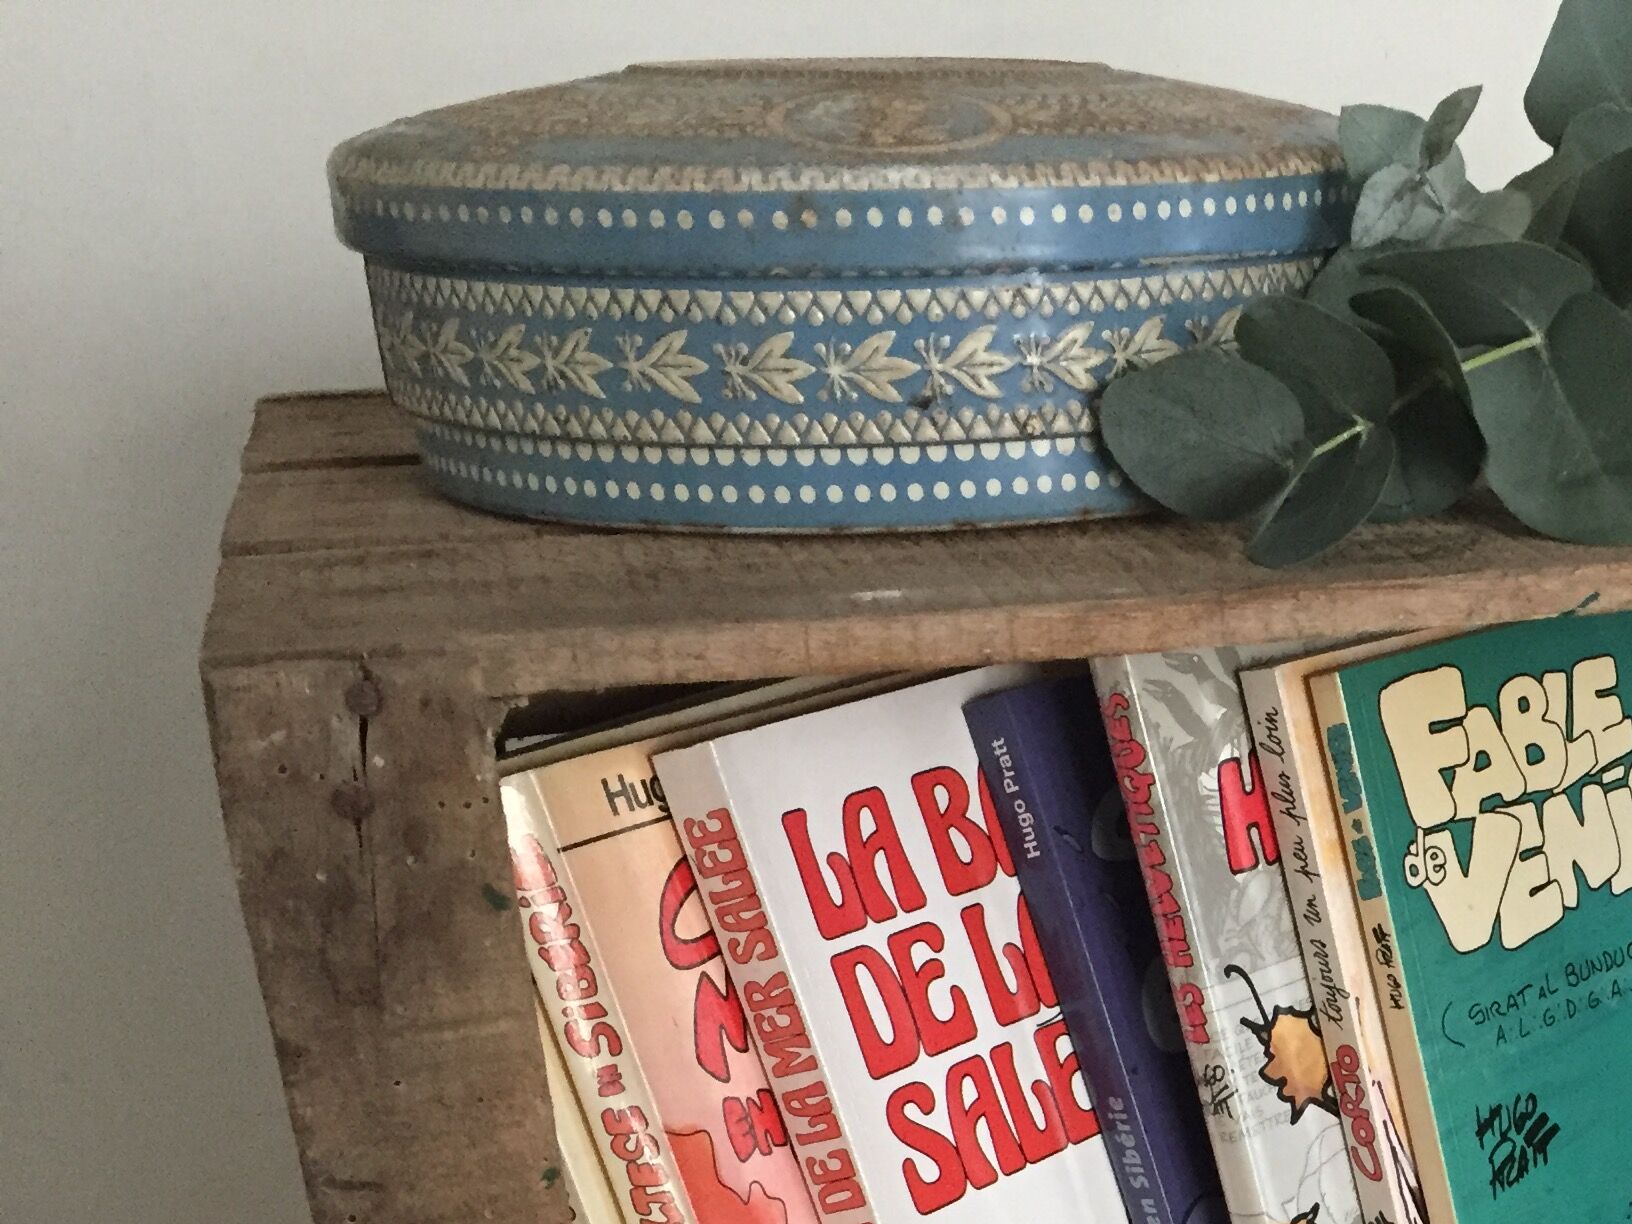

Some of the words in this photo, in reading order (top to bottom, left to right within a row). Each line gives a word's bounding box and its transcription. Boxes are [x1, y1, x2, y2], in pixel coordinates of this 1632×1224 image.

[992, 738, 1019, 794] Pratt
[1257, 706, 1285, 764] loin
[1012, 797, 1040, 859] Hugo
[1270, 770, 1307, 826] plus
[781, 787, 927, 941] LA
[1293, 835, 1321, 884] peu
[1403, 825, 1447, 888] de
[1303, 894, 1322, 927] un
[831, 922, 978, 1080] DE
[1173, 983, 1210, 1044] LES
[1310, 938, 1350, 1030] toujours
[744, 971, 819, 1079] MER
[782, 1081, 843, 1147] LA
[1108, 1096, 1150, 1189] Sibérie
[1330, 1045, 1382, 1182] CORTO
[806, 1148, 867, 1216] DE
